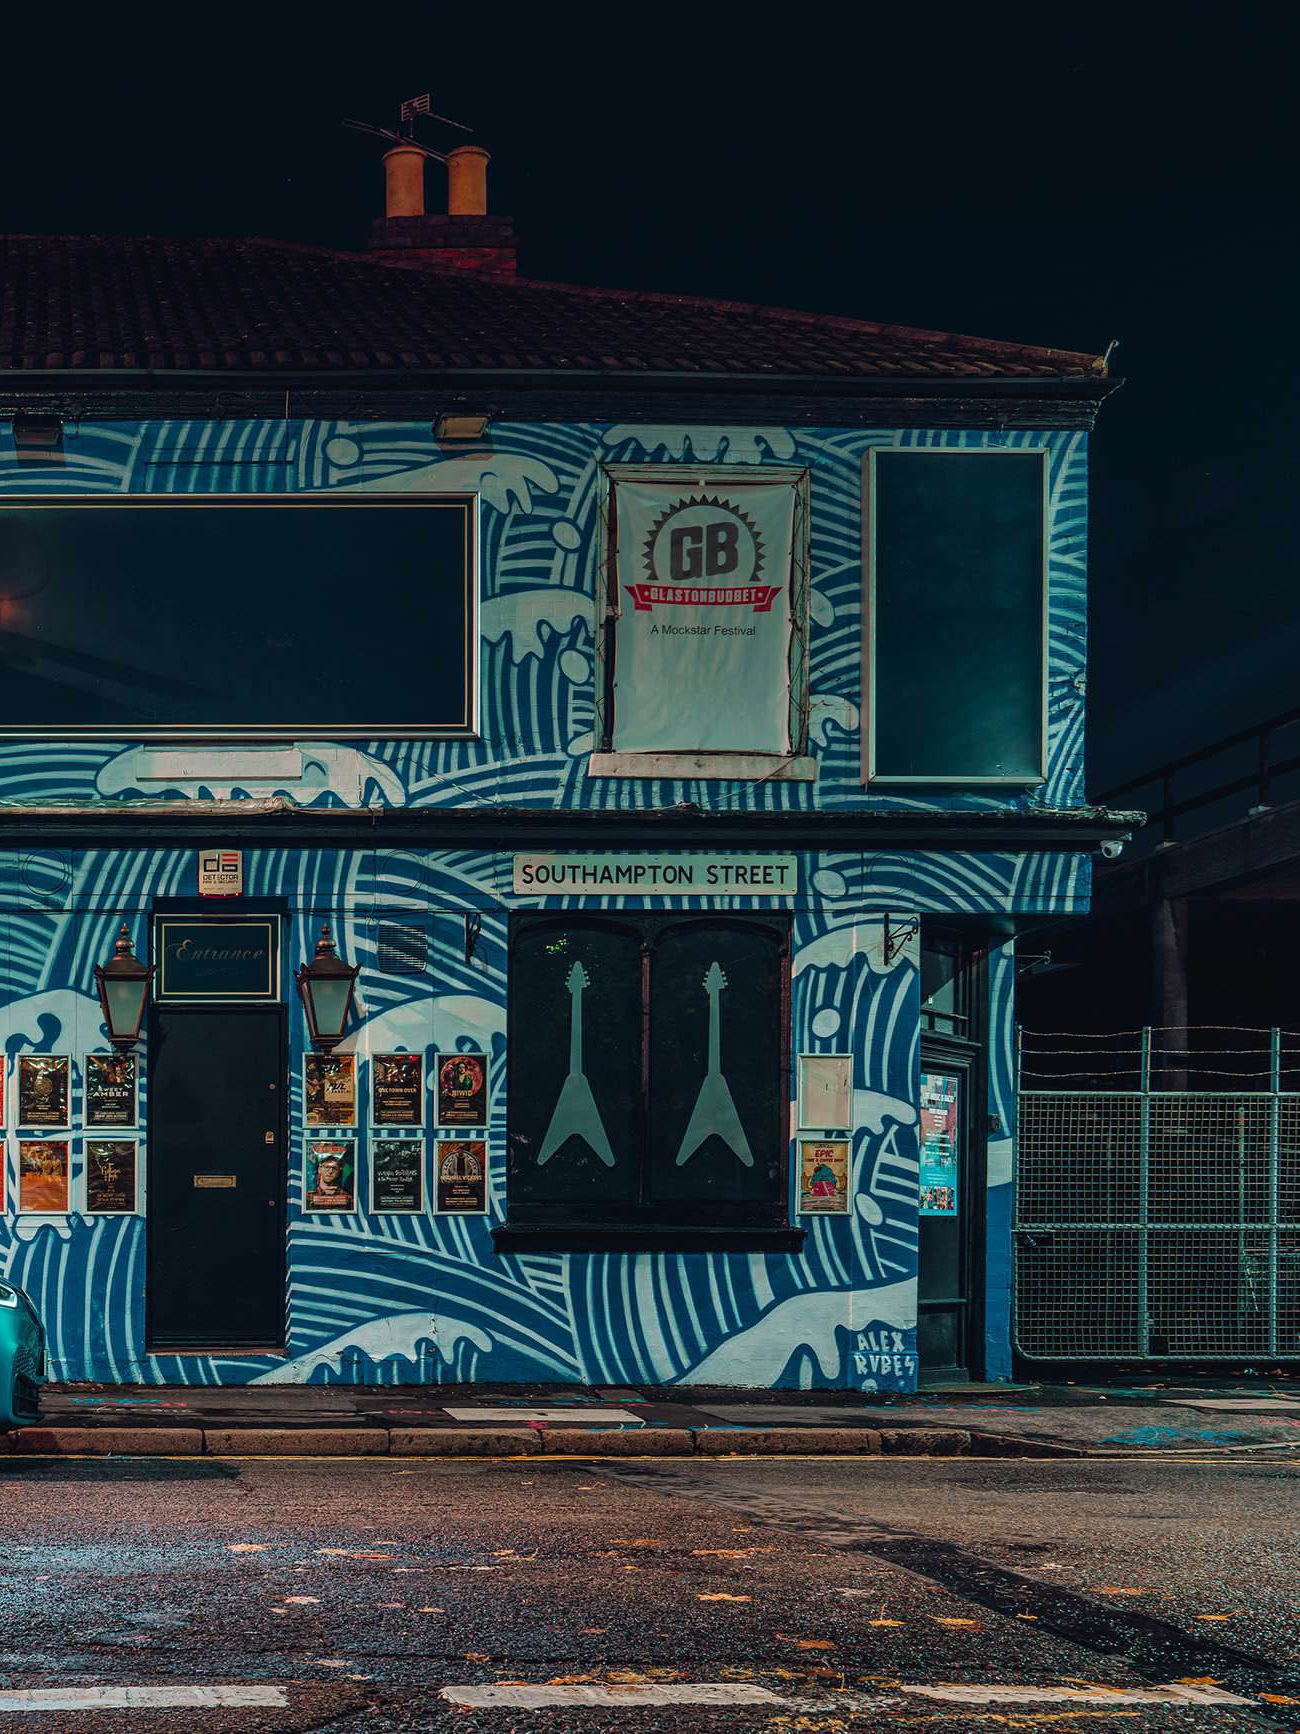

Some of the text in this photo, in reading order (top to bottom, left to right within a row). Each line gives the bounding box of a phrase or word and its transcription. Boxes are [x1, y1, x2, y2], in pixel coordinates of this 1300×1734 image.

[670, 521, 739, 581] GB
[651, 625, 756, 636] A Mockstar Festival
[521, 864, 789, 885] SOUTHAMPTON STREET
[166, 939, 266, 961] Entrance
[815, 1150, 834, 1158] EPIC
[857, 1330, 905, 1353] ALEX
